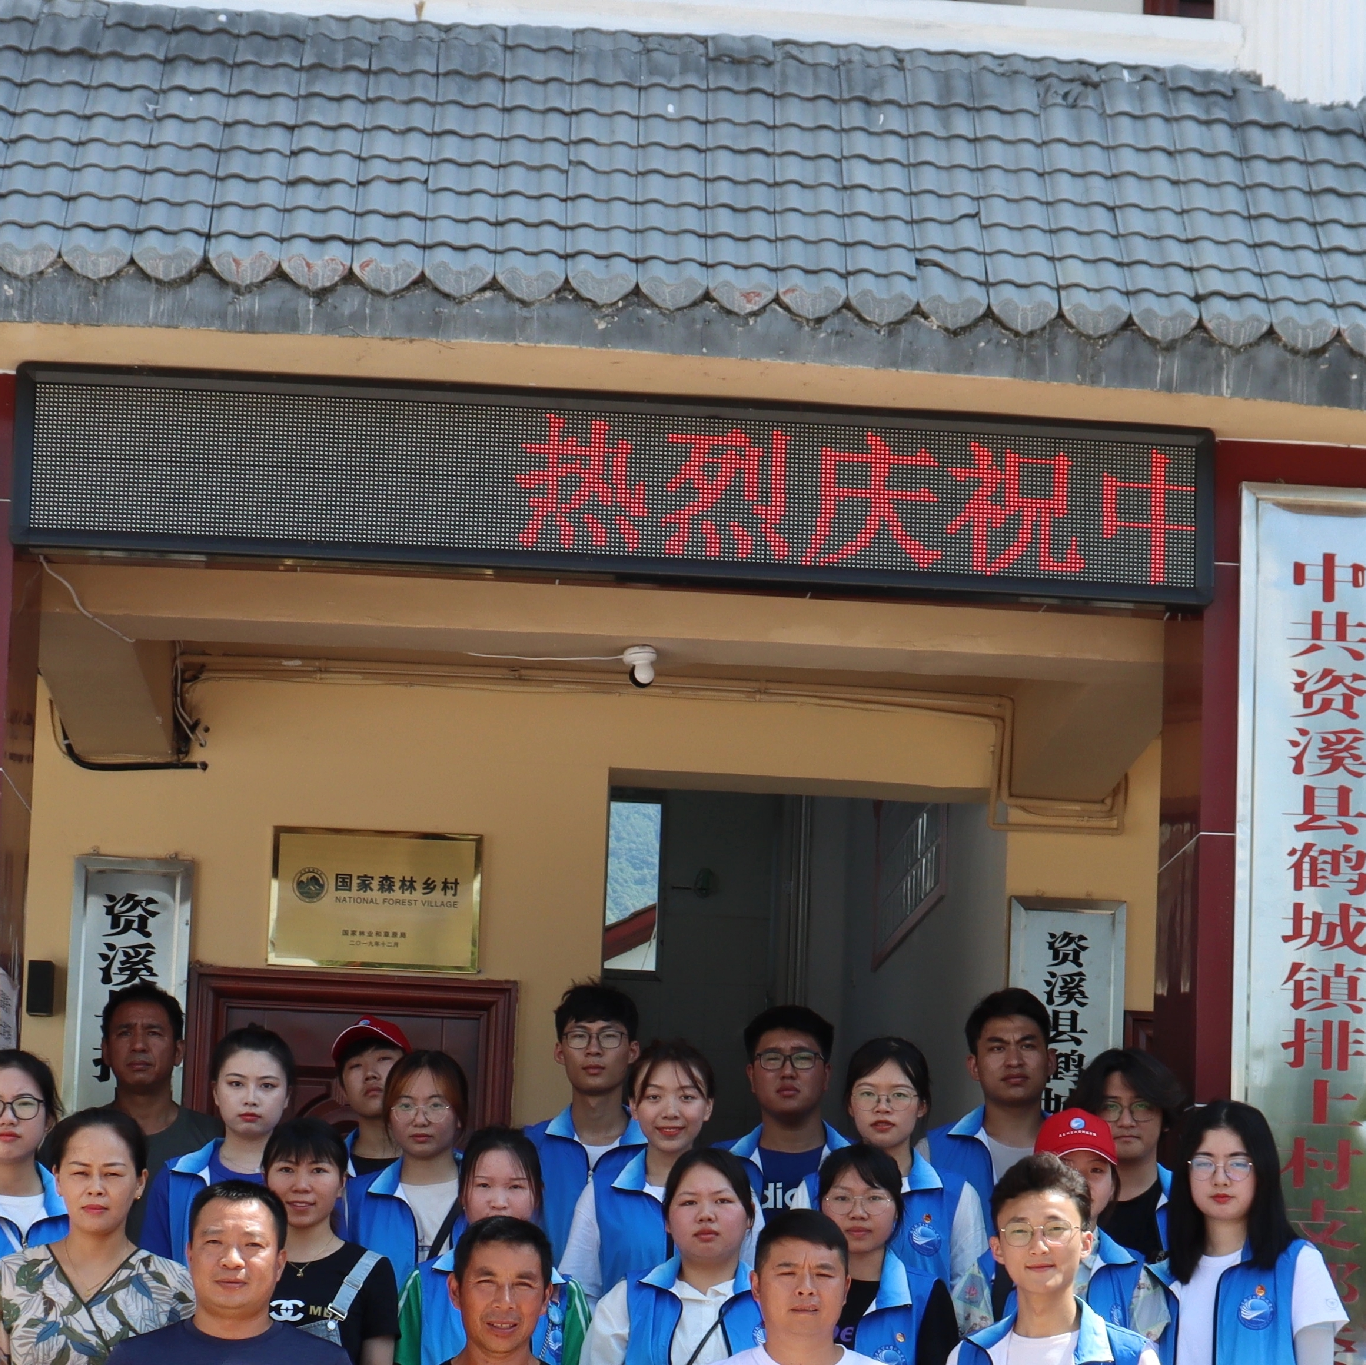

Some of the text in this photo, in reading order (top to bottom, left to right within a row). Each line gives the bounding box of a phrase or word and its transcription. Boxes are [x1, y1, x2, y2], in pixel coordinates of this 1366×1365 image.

[515, 413, 1197, 588] 热烈庆祝中
[335, 873, 460, 897] 国家森林乡村
[335, 896, 380, 905] NATIONAL
[382, 898, 418, 906] FOREST
